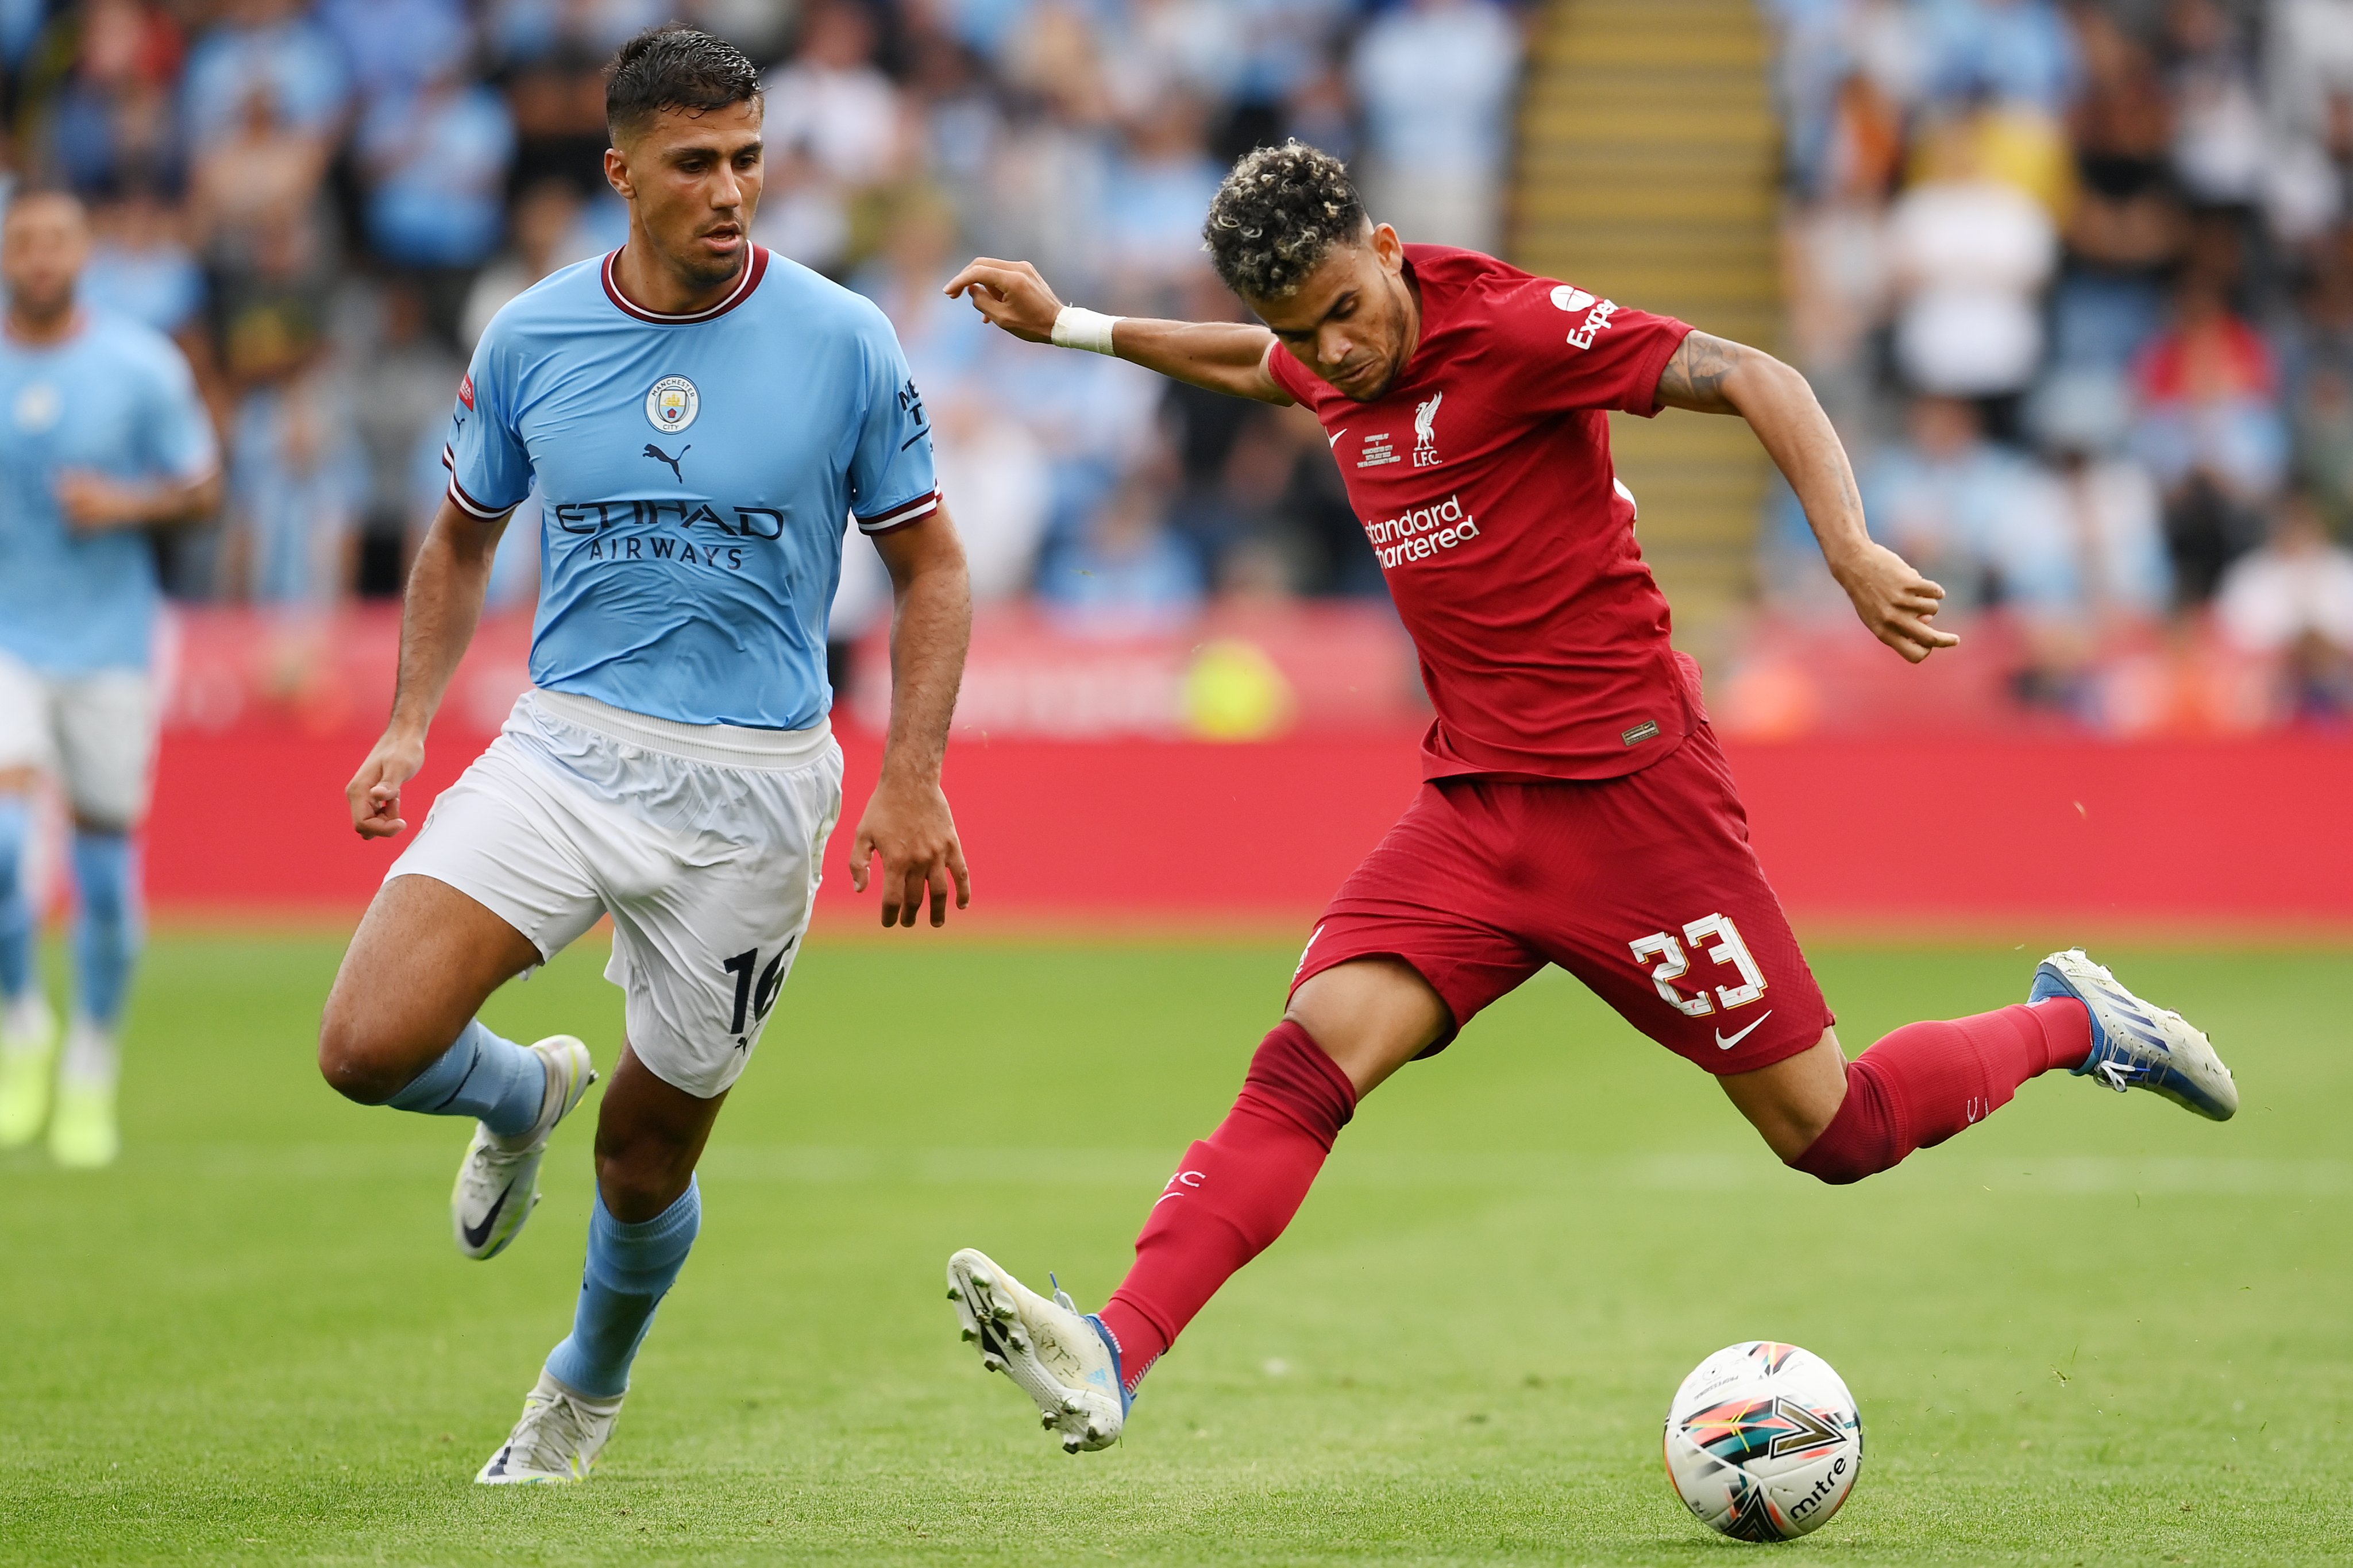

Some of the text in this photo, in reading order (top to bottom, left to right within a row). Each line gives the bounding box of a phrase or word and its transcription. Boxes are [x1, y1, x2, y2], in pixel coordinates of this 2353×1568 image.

[651, 379, 695, 398] MANCHESTER
[1413, 450, 1442, 468] L.F.C.
[556, 500, 784, 540] ETIHAD
[1375, 514, 1480, 570] hartered
[589, 537, 742, 570] AIRWAYS
[723, 934, 796, 1035] 16
[1628, 912, 1769, 1018] 23
[1790, 1458, 1846, 1520] mitre
